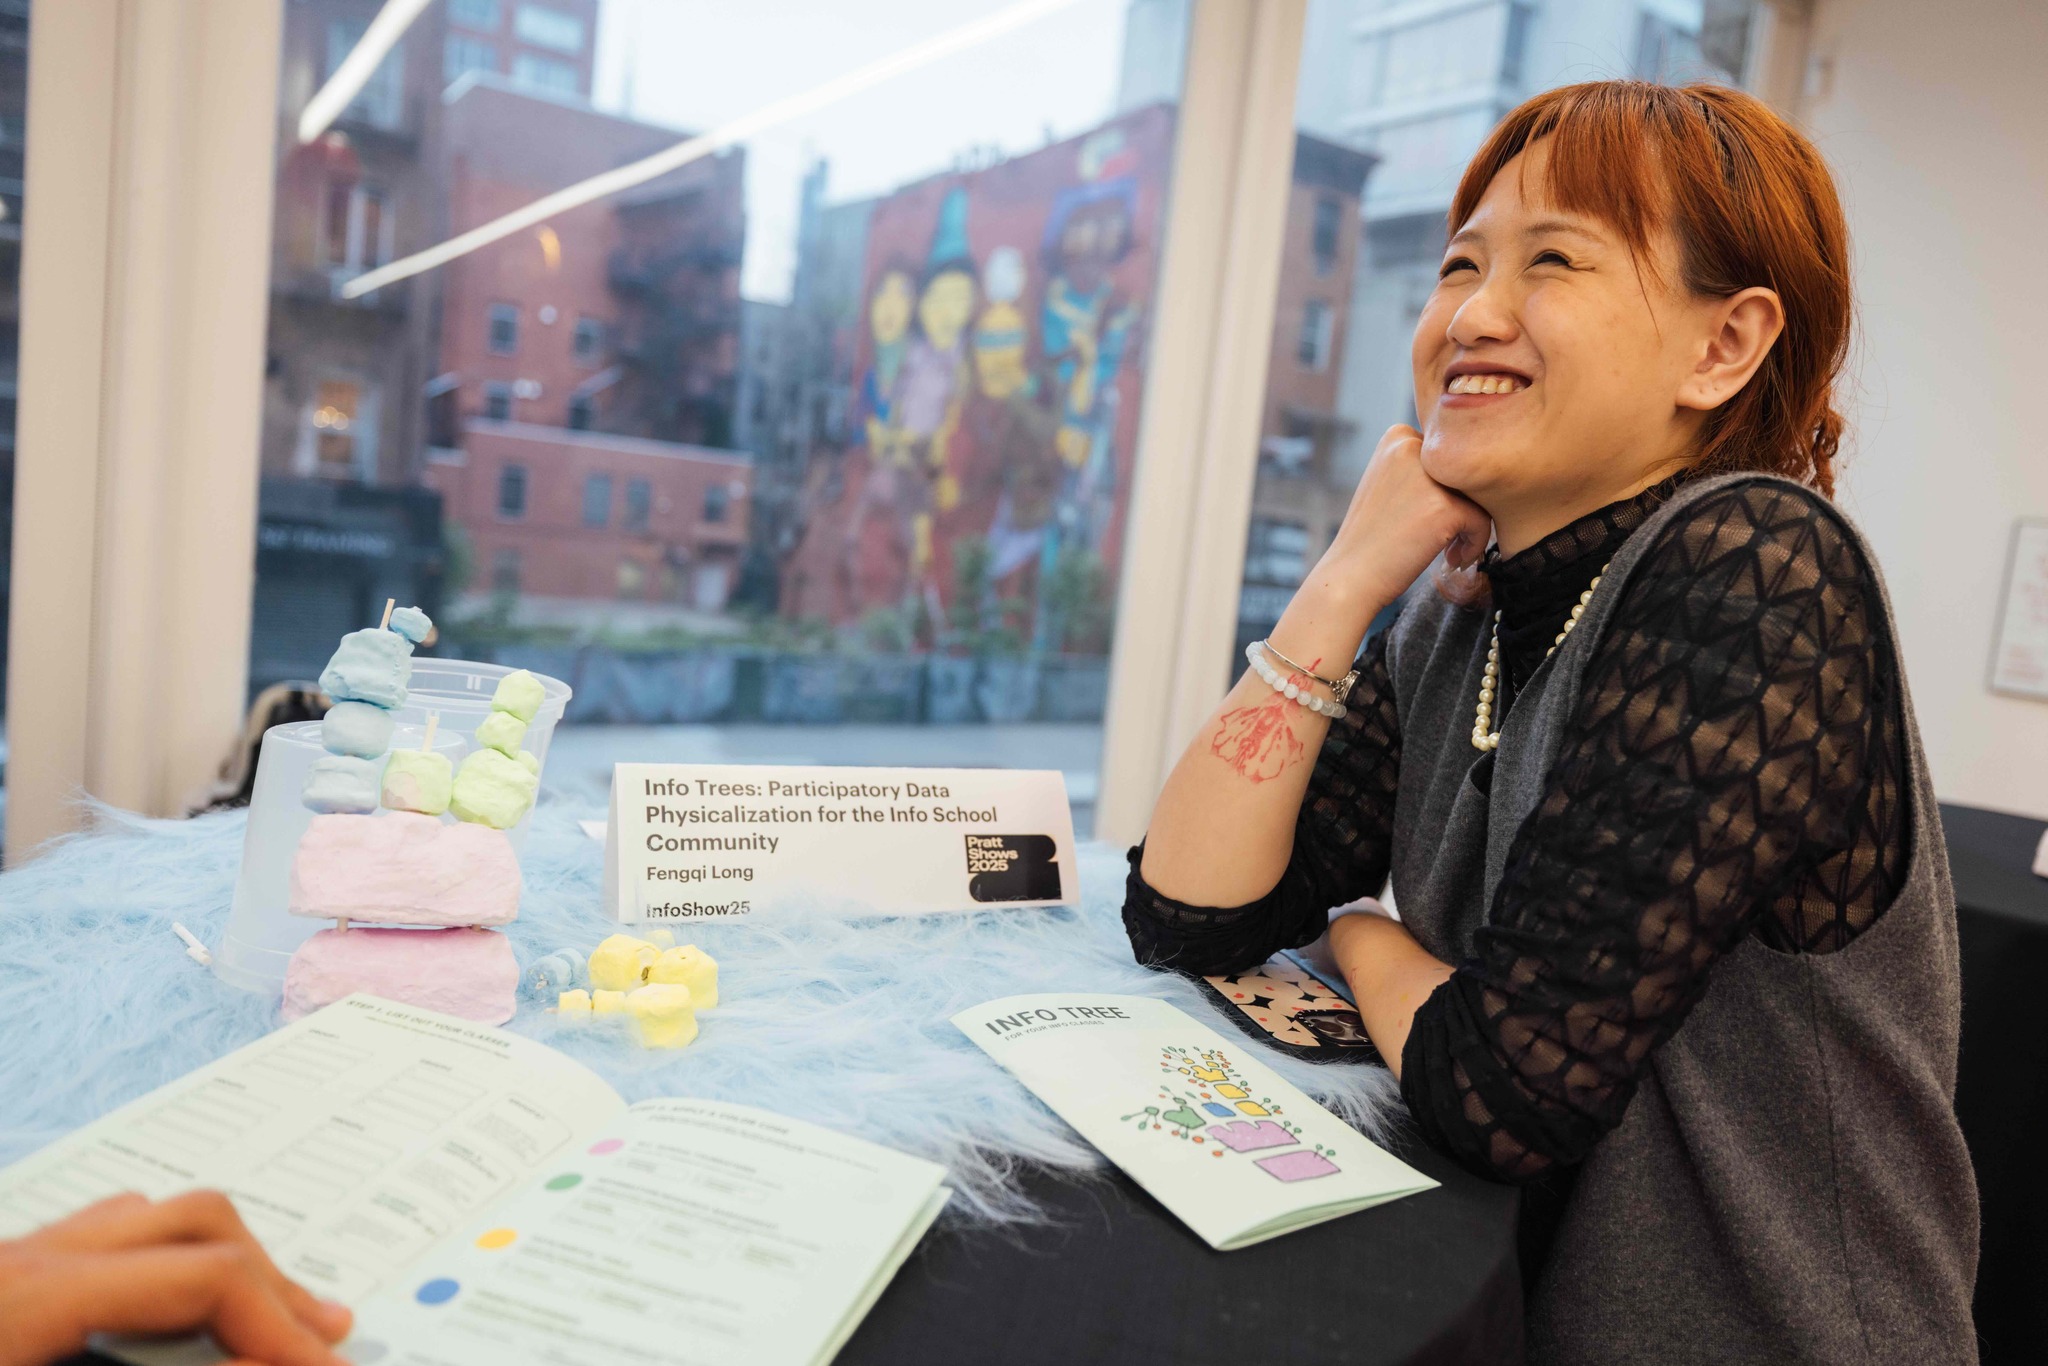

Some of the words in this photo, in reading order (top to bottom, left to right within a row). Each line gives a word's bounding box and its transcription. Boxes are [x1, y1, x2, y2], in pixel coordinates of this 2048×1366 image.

[645, 778, 690, 797] Info
[695, 779, 763, 797] Trees:
[768, 780, 901, 801] Participatory
[906, 782, 950, 798] Data
[646, 805, 813, 827] Physicalization
[817, 805, 847, 823] for
[852, 806, 885, 823] the
[890, 806, 928, 823] Info
[932, 806, 998, 823] School
[646, 832, 780, 854] Community
[967, 836, 1004, 849] Pratt
[968, 848, 1019, 860] Shows
[646, 865, 707, 883] Fengqi
[712, 866, 754, 882] Long
[969, 860, 1009, 872] 2025
[985, 1008, 1058, 1035] INFO
[1057, 1006, 1132, 1019] TREE
[1004, 1031, 1024, 1042] FOR
[1025, 1025, 1048, 1034] YOUR
[1048, 1021, 1069, 1030] INFO
